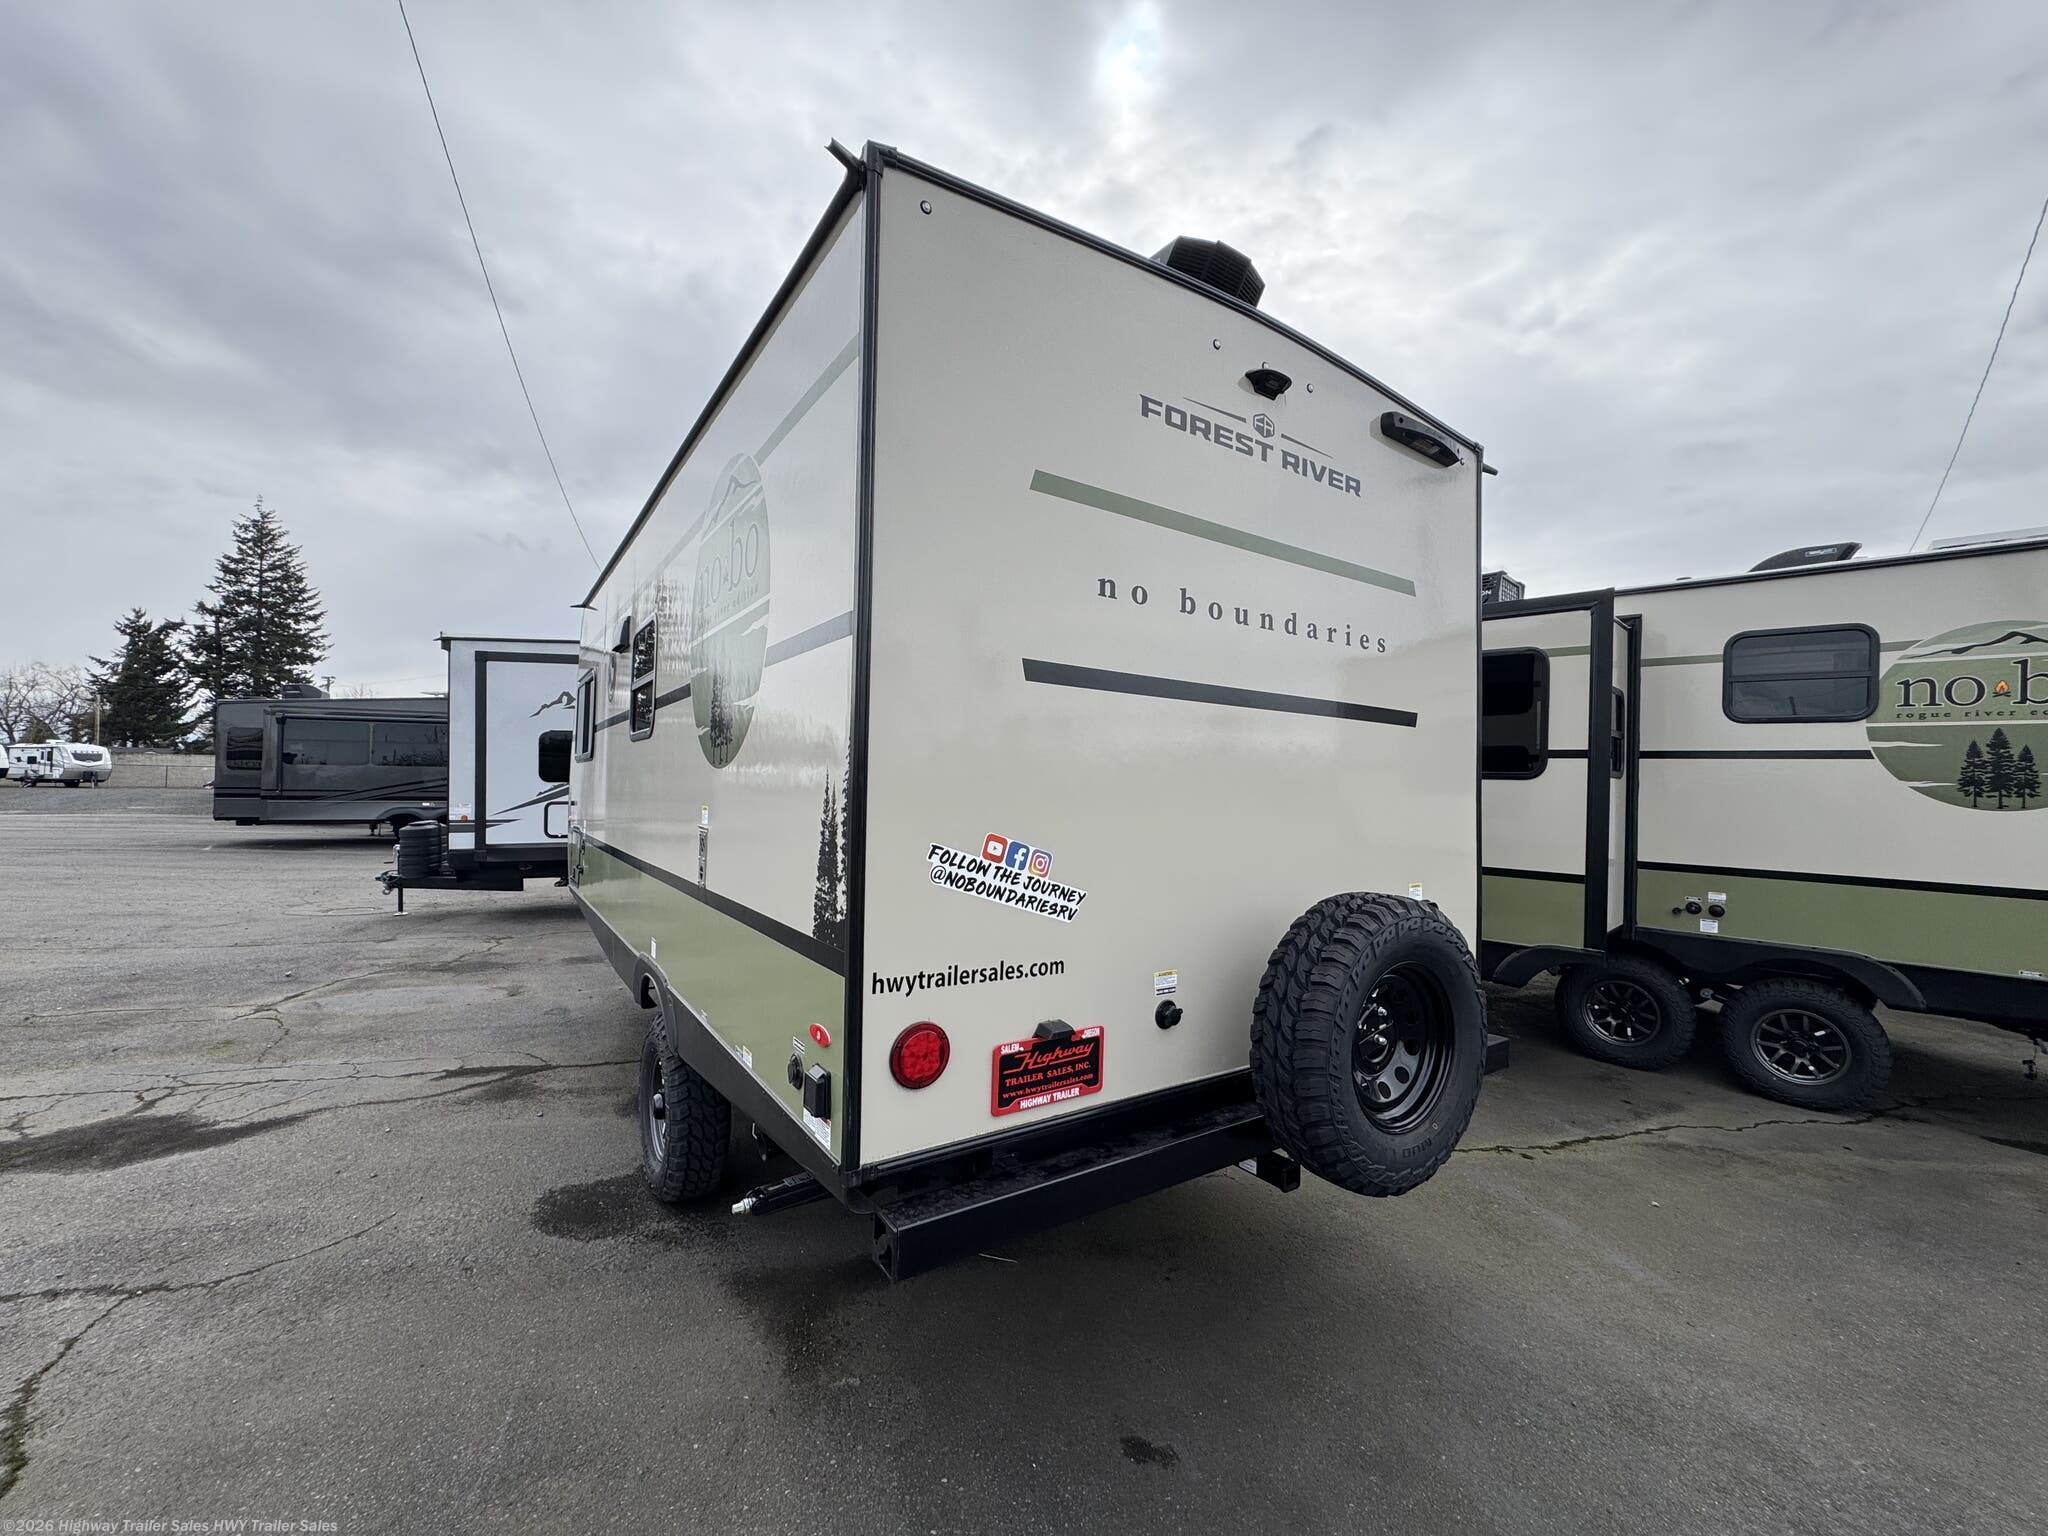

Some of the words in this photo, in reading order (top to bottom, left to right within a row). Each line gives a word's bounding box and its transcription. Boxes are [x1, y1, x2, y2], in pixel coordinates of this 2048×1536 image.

[1140, 394, 1274, 463] FOREST
[1281, 449, 1361, 498] RIVER
[1097, 576, 1149, 606] no
[1179, 588, 1387, 654] boundaries
[1896, 711, 1952, 720] rogue
[1964, 709, 2017, 717] river
[928, 844, 992, 878] FOLLOW
[993, 865, 1022, 885] THE
[1023, 876, 1087, 906] JOURNEY
[930, 865, 1079, 921] @NOBOUNDARIESRV
[871, 960, 1065, 997] hwytrailersales.com
[1004, 1043, 1095, 1073] Highway
[1004, 1072, 1044, 1087] TRAILER
[1046, 1065, 1074, 1078] SALES,
[1075, 1061, 1092, 1071] INC.
[1003, 1073, 1094, 1099] www.hwytrailersales.com
[1020, 1094, 1052, 1109] HIGHWAY
[1053, 1087, 1080, 1101] TRAILER
